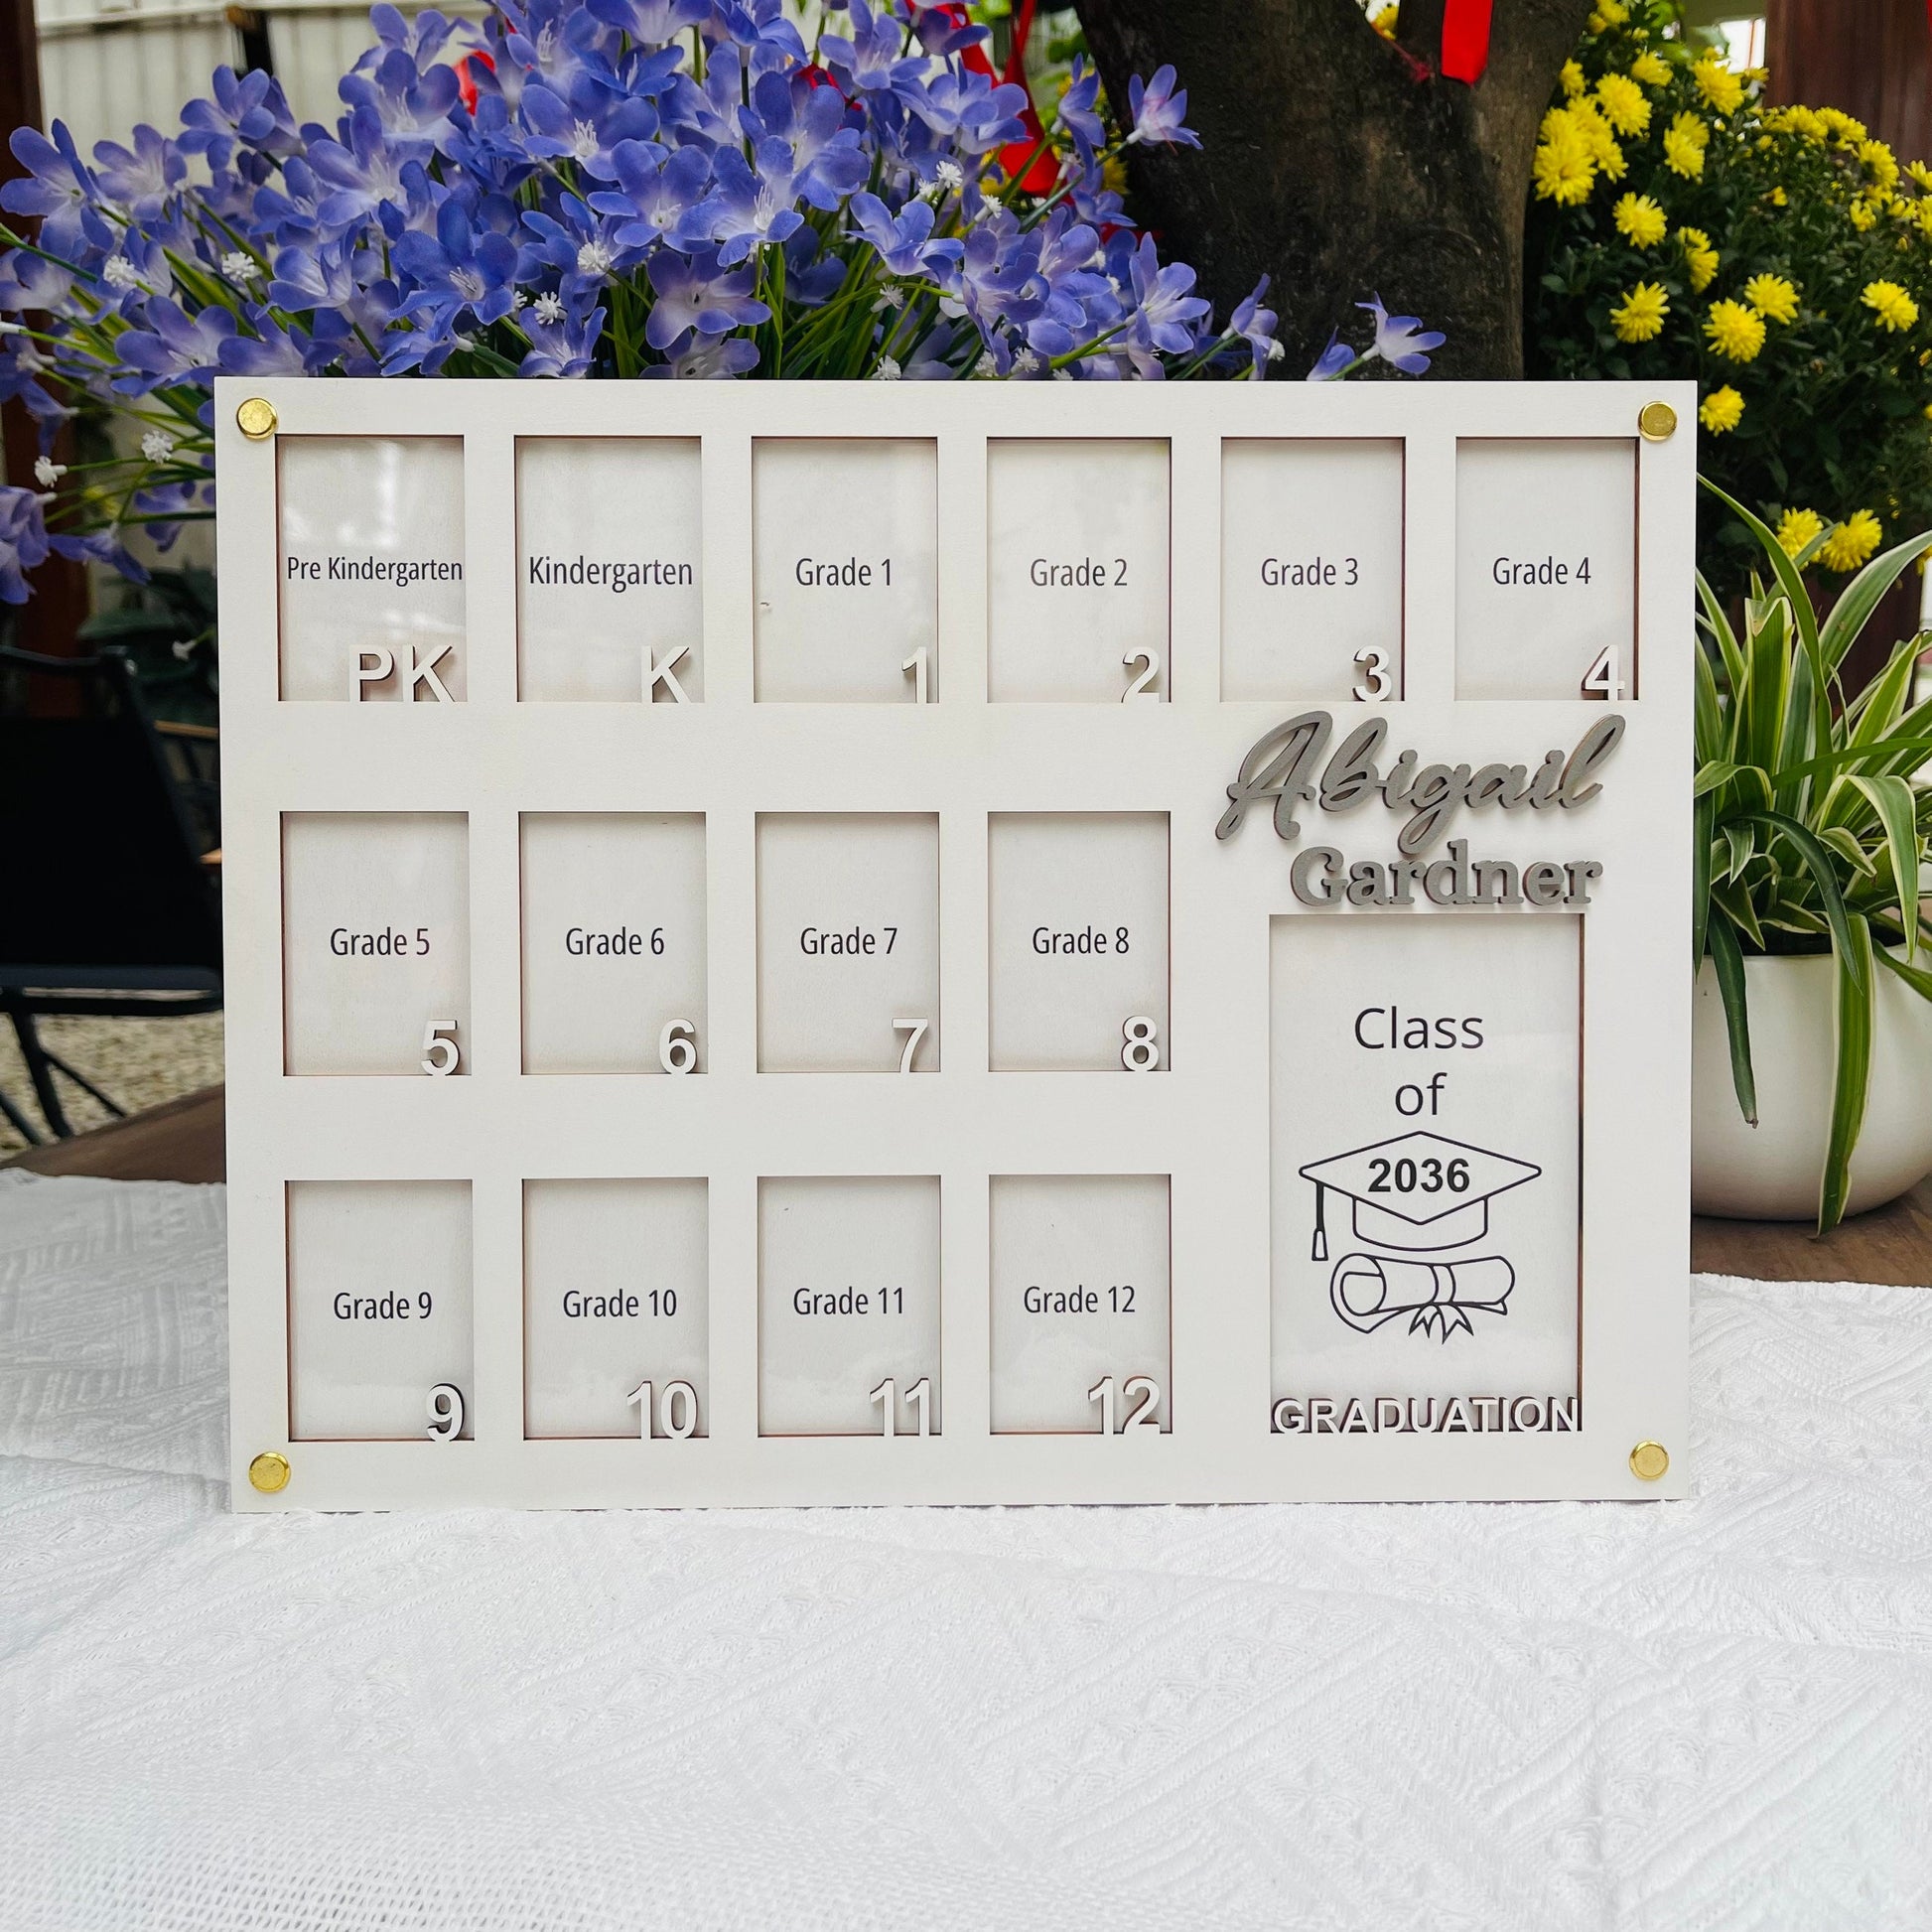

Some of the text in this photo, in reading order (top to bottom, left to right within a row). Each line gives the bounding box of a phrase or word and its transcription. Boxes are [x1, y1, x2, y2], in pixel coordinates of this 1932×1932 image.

[288, 556, 464, 587] Pre Kindergarten
[530, 556, 693, 593] Kindergarten
[795, 557, 891, 586] Grade 1
[1030, 557, 1128, 586] Grade 2
[1261, 556, 1358, 585] Grade 3
[1492, 555, 1591, 585] Grade 4
[353, 643, 456, 703] PK
[640, 643, 692, 703] K
[900, 645, 928, 703] 1
[1122, 645, 1161, 702] 2
[1352, 644, 1392, 701] 3
[1581, 643, 1625, 700] 4
[1214, 710, 1626, 854] Abigail
[1290, 838, 1602, 906] Gardner
[330, 926, 430, 955] Grade 5
[565, 926, 665, 955] Grade 6
[800, 925, 898, 954] Grade 7
[1032, 925, 1130, 954] Grade 8
[420, 1018, 461, 1075] 5
[657, 1018, 697, 1074] 6
[892, 1017, 930, 1073] 7
[1120, 1015, 1161, 1071] 8
[1354, 1006, 1484, 1049] Class
[1395, 1072, 1449, 1116] of
[1367, 1158, 1470, 1193] 2036
[333, 1290, 433, 1319] Grade 9
[563, 1288, 677, 1317] Grade 10
[793, 1286, 902, 1314] Grade 11
[1024, 1284, 1136, 1313] Grade 12
[425, 1382, 465, 1442] 9
[625, 1378, 697, 1439] 10
[869, 1376, 934, 1437] 11
[1087, 1375, 1162, 1434] 12
[1271, 1397, 1579, 1434] GRADUATION
